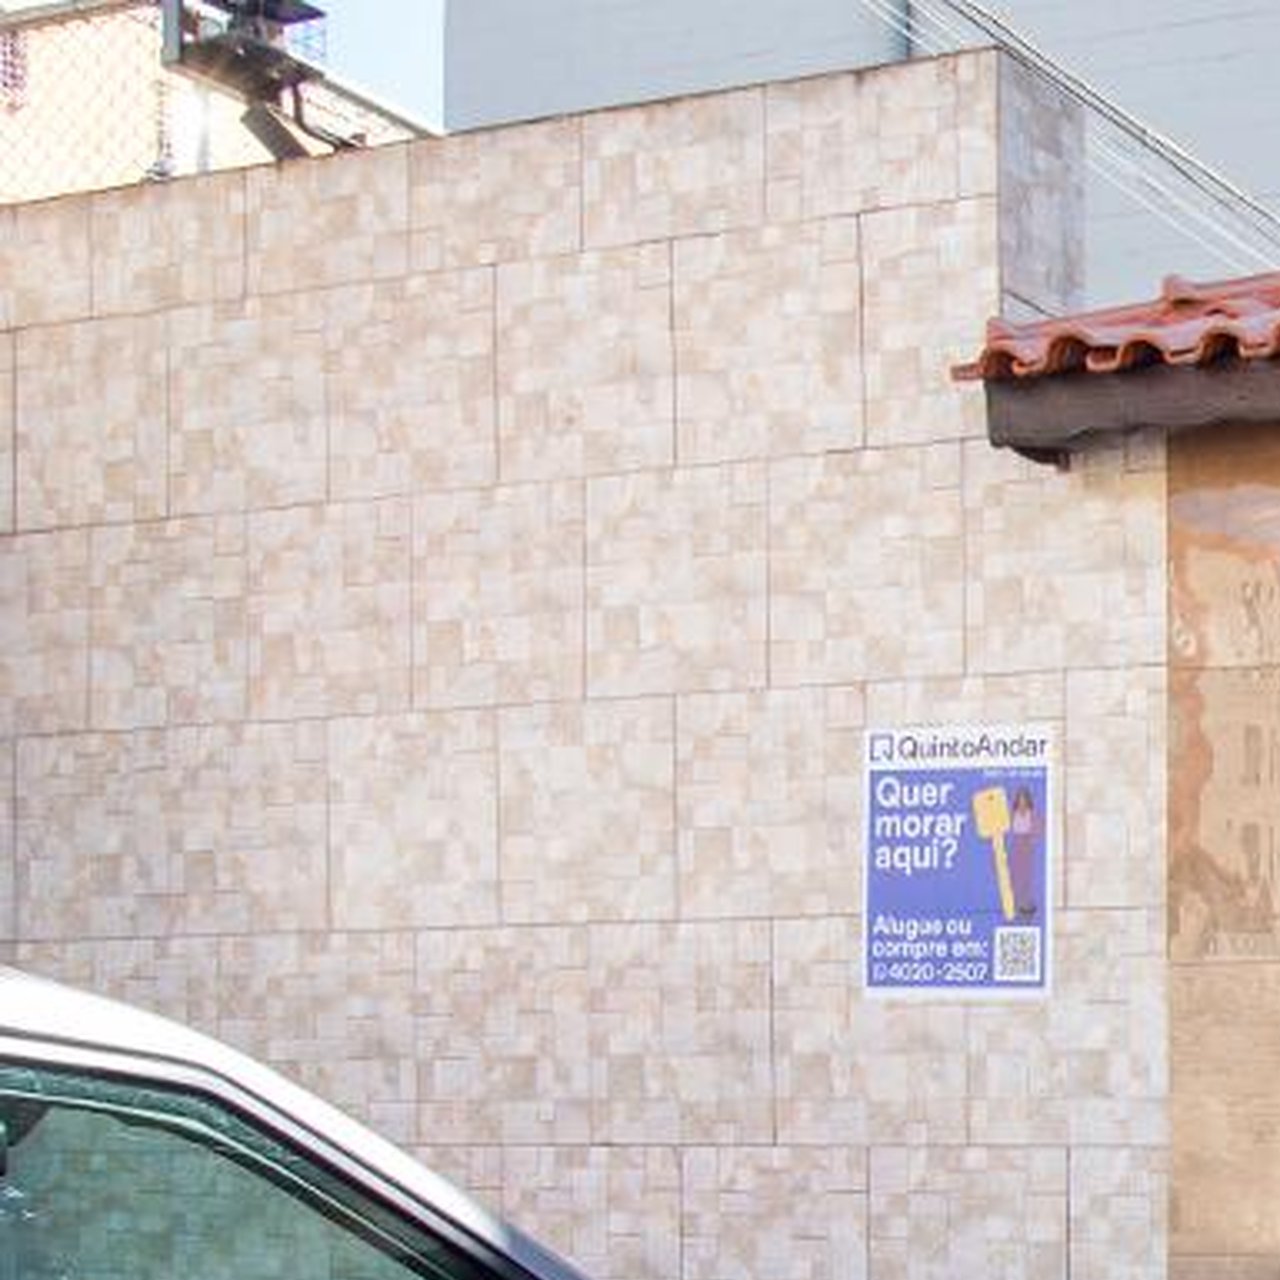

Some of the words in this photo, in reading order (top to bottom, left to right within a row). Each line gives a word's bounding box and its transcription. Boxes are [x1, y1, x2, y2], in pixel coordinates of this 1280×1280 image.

[899, 734, 1047, 759] QuintoAndar
[876, 777, 953, 807] Quer
[875, 812, 965, 838] morar
[875, 839, 957, 875] aqui?
[946, 919, 972, 934] ou
[873, 941, 948, 959] compre
